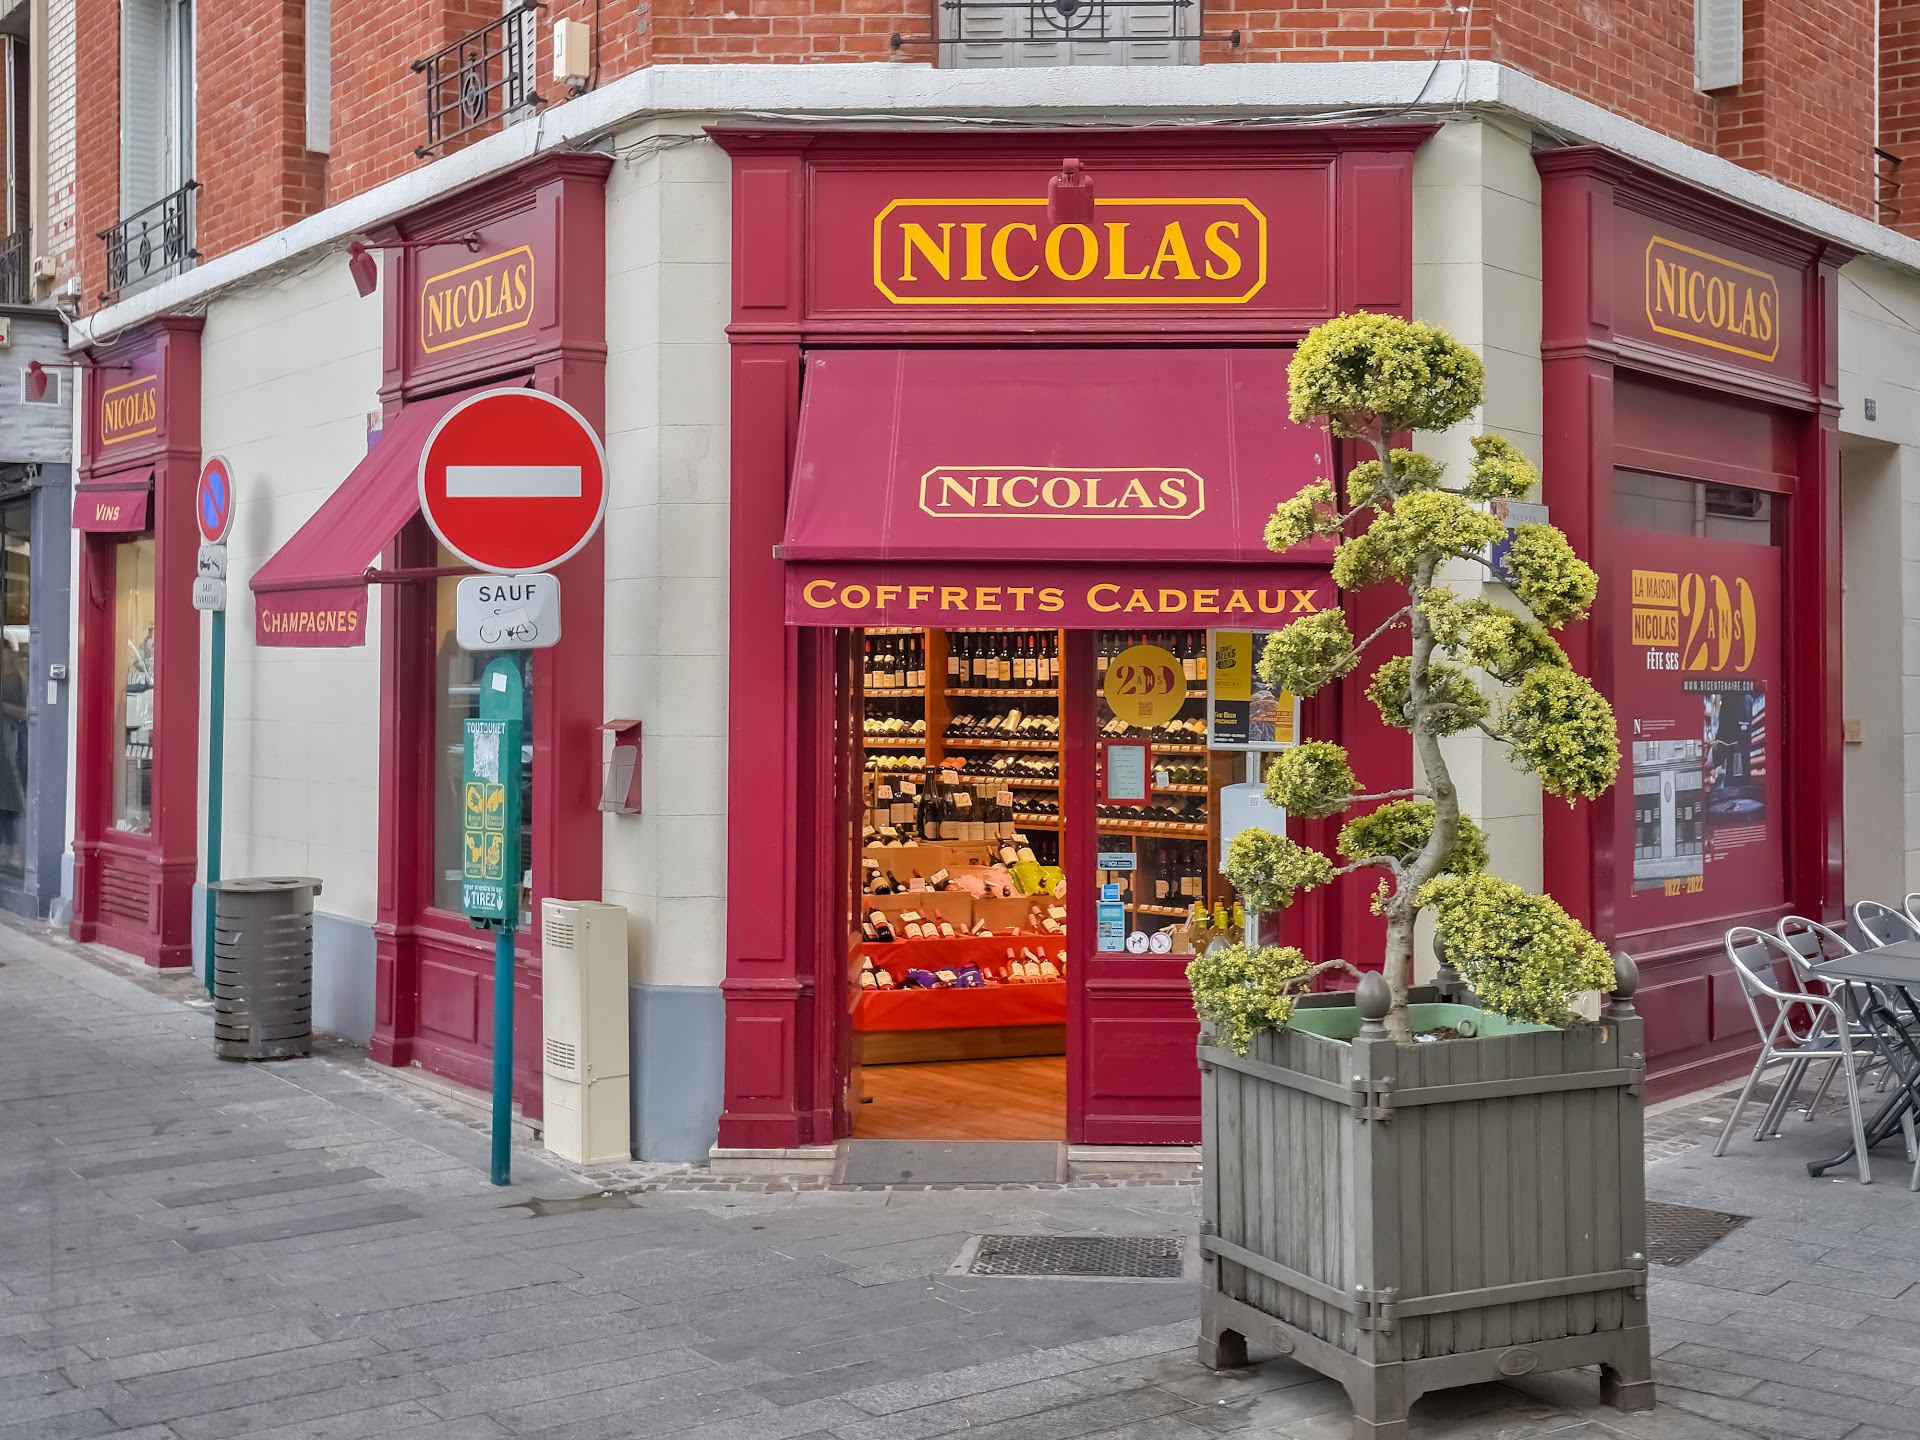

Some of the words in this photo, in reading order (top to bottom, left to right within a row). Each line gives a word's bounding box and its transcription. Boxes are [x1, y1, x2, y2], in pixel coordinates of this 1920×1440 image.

[898, 220, 1242, 282] NICOLAS
[427, 263, 527, 338] NICOLAS
[1654, 257, 1772, 342] NICOLAS
[104, 387, 157, 434] NICOLAS
[936, 475, 1189, 510] NICOLAS
[1508, 513, 1537, 523] URESNES
[478, 584, 537, 602] SAUF
[802, 578, 1065, 613] COFFRETS
[1086, 582, 1319, 615] CADEAUX
[1634, 576, 1644, 598] LA
[1646, 577, 1677, 600] MAISON
[1634, 614, 1677, 641] NICOLAS
[1707, 608, 1742, 642] ANS
[1646, 647, 1664, 671] FÊTE
[1665, 652, 1679, 671] SES
[1136, 675, 1163, 686] ANS
[466, 721, 506, 735] TOUTOUNET
[1633, 718, 1642, 735] N
[1664, 878, 1681, 897] 1822
[1686, 874, 1704, 894] 2022
[471, 890, 496, 907] TIREZ
